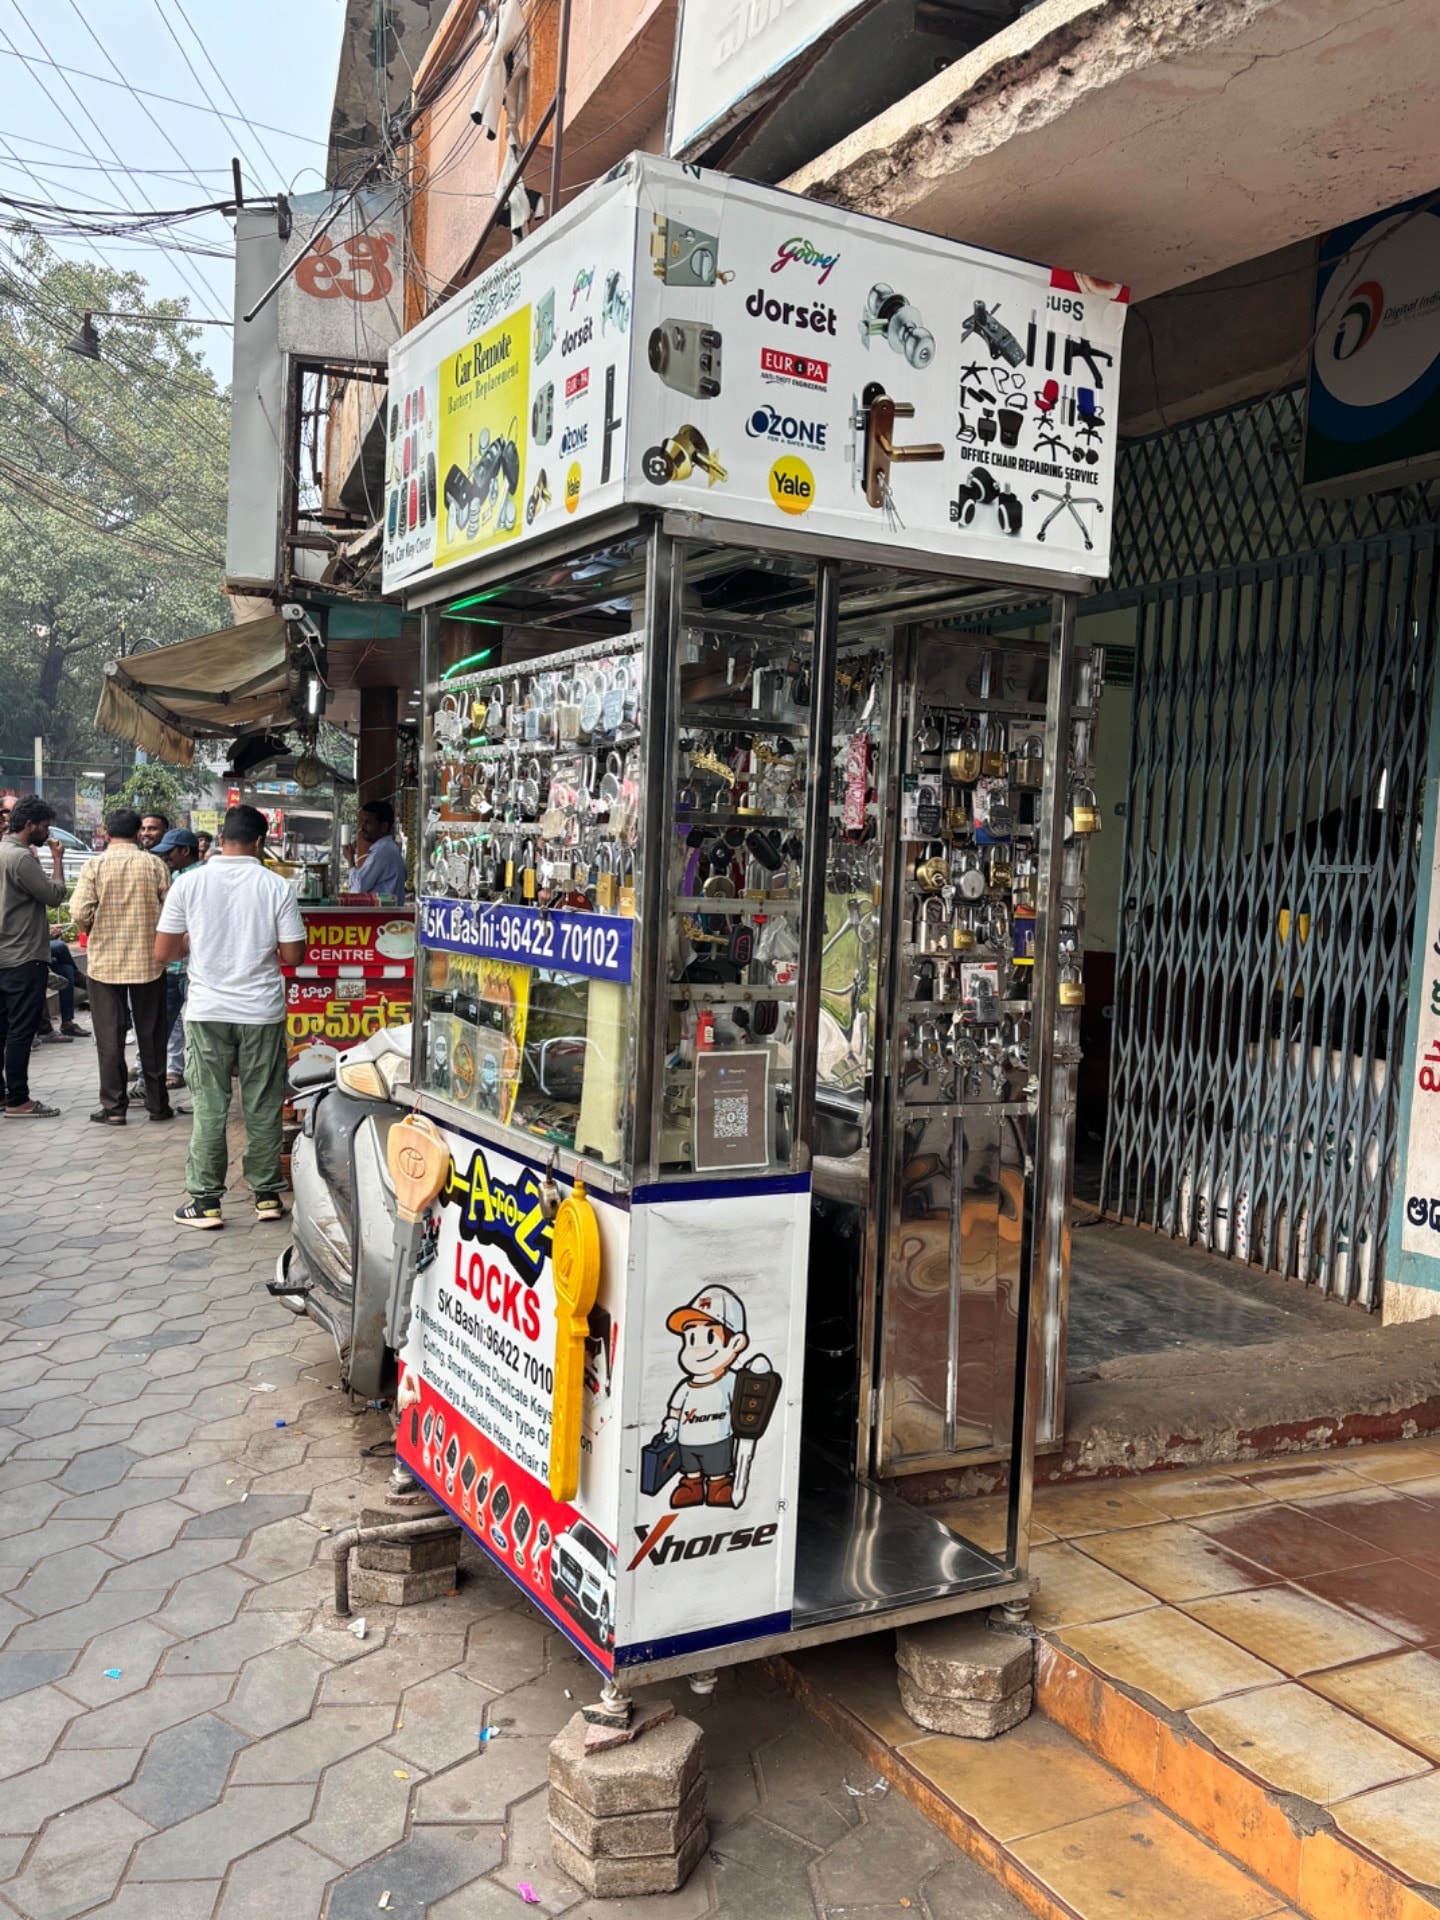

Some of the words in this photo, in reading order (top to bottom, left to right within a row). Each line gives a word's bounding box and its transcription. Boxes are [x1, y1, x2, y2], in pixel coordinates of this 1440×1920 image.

[770, 237, 841, 285] Godrej
[745, 288, 838, 336] dorsët
[1383, 297, 1419, 321] Digital
[455, 353, 473, 388] Car
[473, 332, 512, 379] Remote
[447, 390, 473, 415] Battery
[474, 360, 519, 400] Replacement
[745, 404, 828, 446] OZONE
[773, 470, 811, 498] Yale
[960, 446, 991, 466] OFFICE
[991, 452, 1017, 470] CHAIR
[1018, 458, 1064, 480] REPAIRING
[1064, 465, 1099, 486] SERVICE
[304, 925, 373, 946] MDEV
[308, 948, 375, 961] CENTRE
[560, 923, 620, 969] 70102
[467, 1154, 496, 1222] A
[514, 1180, 544, 1265] Z
[454, 1241, 541, 1342] LOCKS
[420, 1306, 449, 1342] Wheelers
[448, 1330, 455, 1348] &
[460, 1339, 492, 1379] Wheelers
[491, 1366, 529, 1408] Duplicate
[529, 1394, 553, 1426] Keys
[421, 1359, 444, 1389] Sensor
[444, 1379, 461, 1407] Keys
[460, 1395, 492, 1435] Available
[514, 1441, 539, 1473] Chair
[447, 1353, 467, 1383] Smart
[467, 1370, 485, 1399] Keys
[484, 1386, 513, 1423] Remote
[514, 1410, 536, 1440] Type
[537, 1428, 550, 1450] Of
[682, 1407, 727, 1426] Xhorse
[625, 1512, 779, 1572] Xhorse
